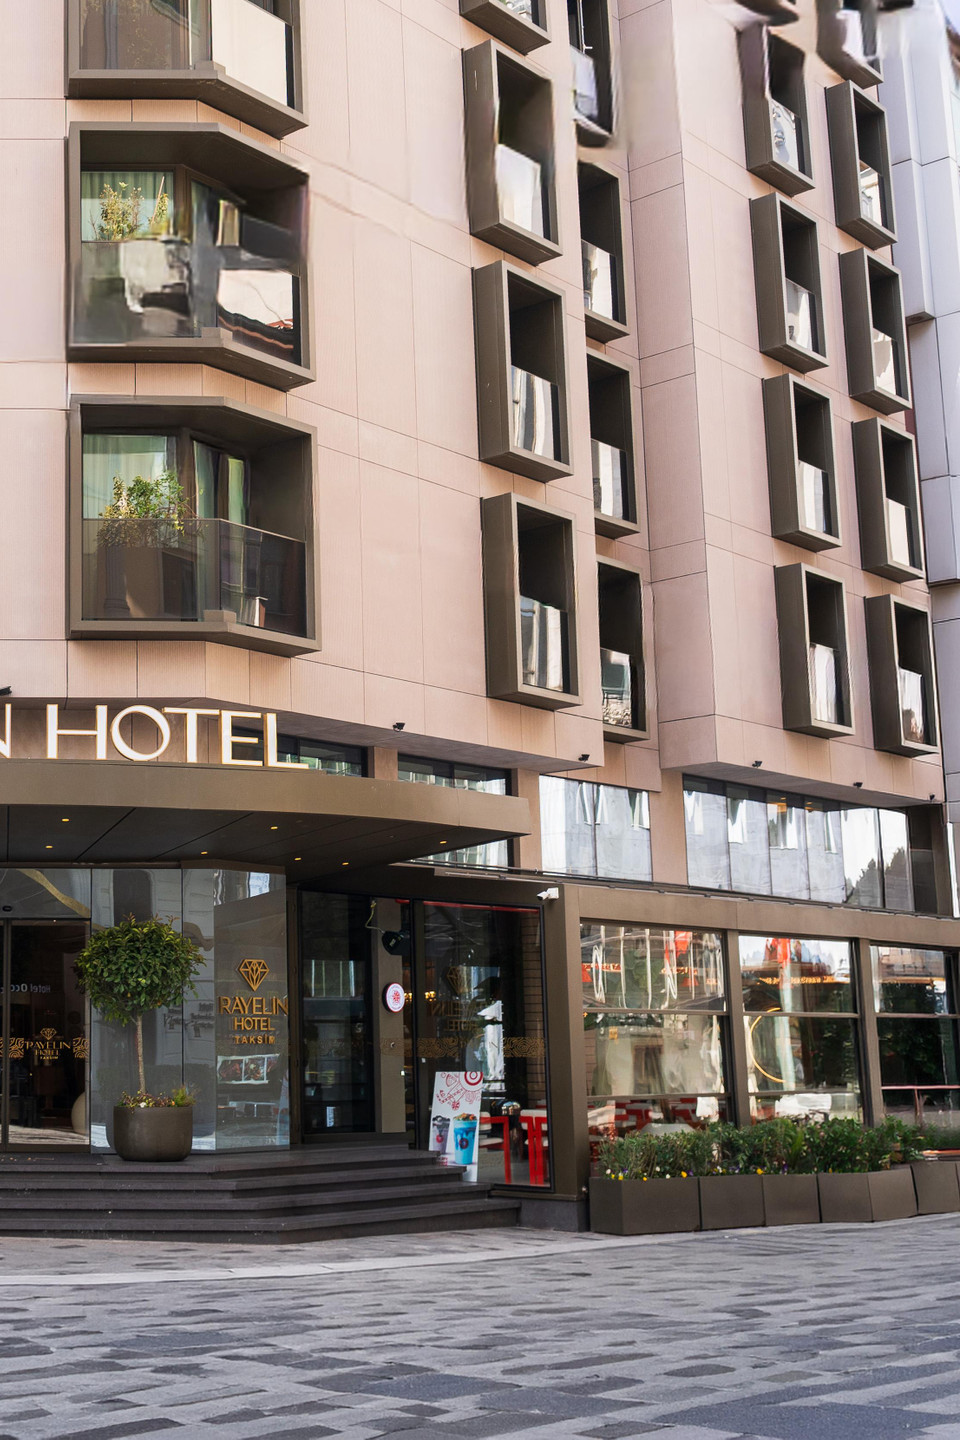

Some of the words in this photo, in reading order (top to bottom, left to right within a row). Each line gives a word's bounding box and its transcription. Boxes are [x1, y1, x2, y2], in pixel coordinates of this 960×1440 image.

[46, 704, 309, 769] HOTEL
[219, 996, 288, 1015] RAYELIN
[233, 1017, 276, 1030] HOTEL
